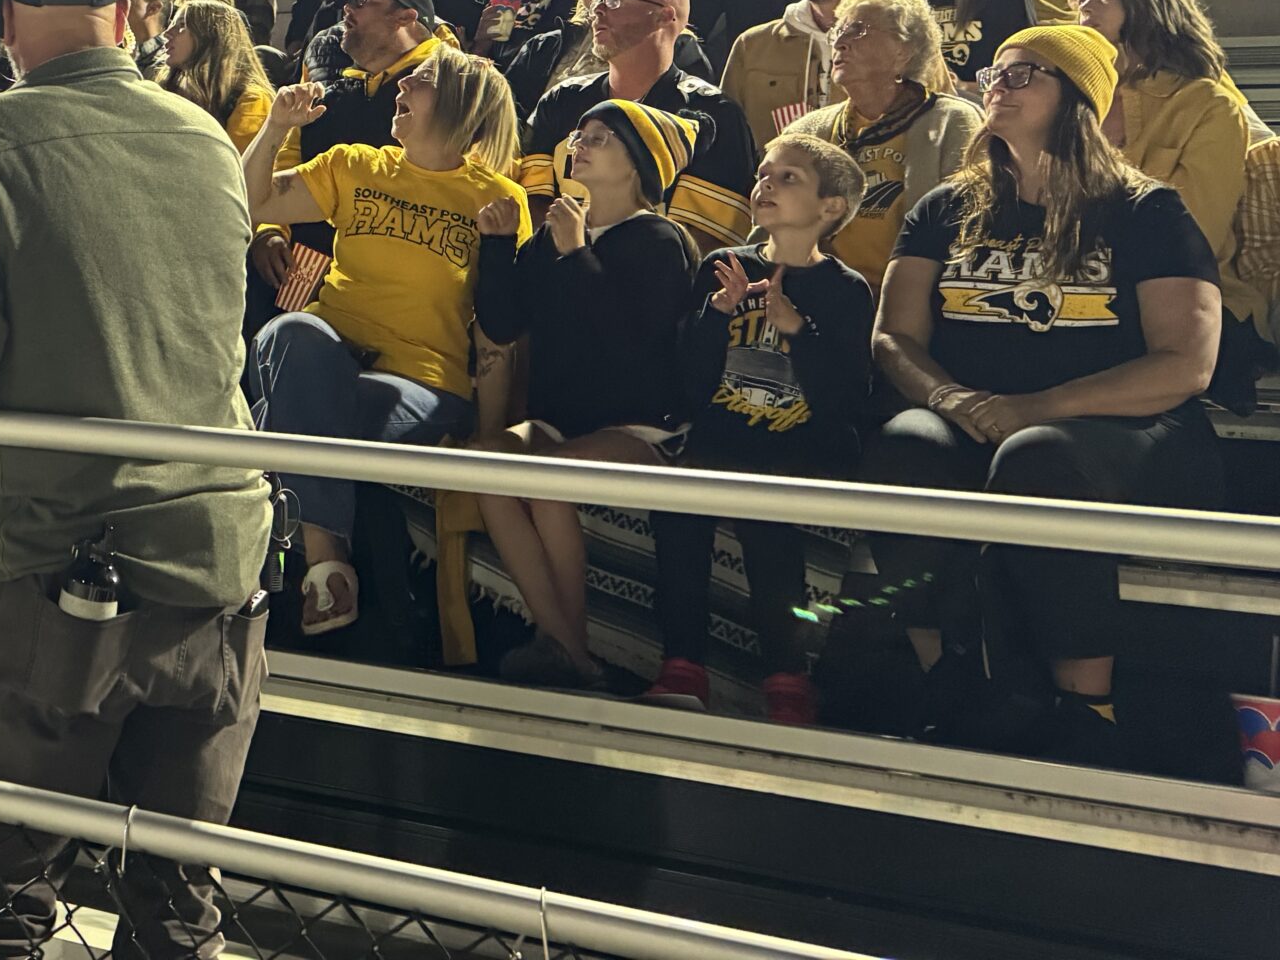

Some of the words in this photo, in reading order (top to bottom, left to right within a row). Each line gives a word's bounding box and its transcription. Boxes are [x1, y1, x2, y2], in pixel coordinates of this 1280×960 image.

[942, 20, 983, 42] MS
[354, 187, 437, 217] SOUTHEAST
[344, 198, 477, 269] RAMS
